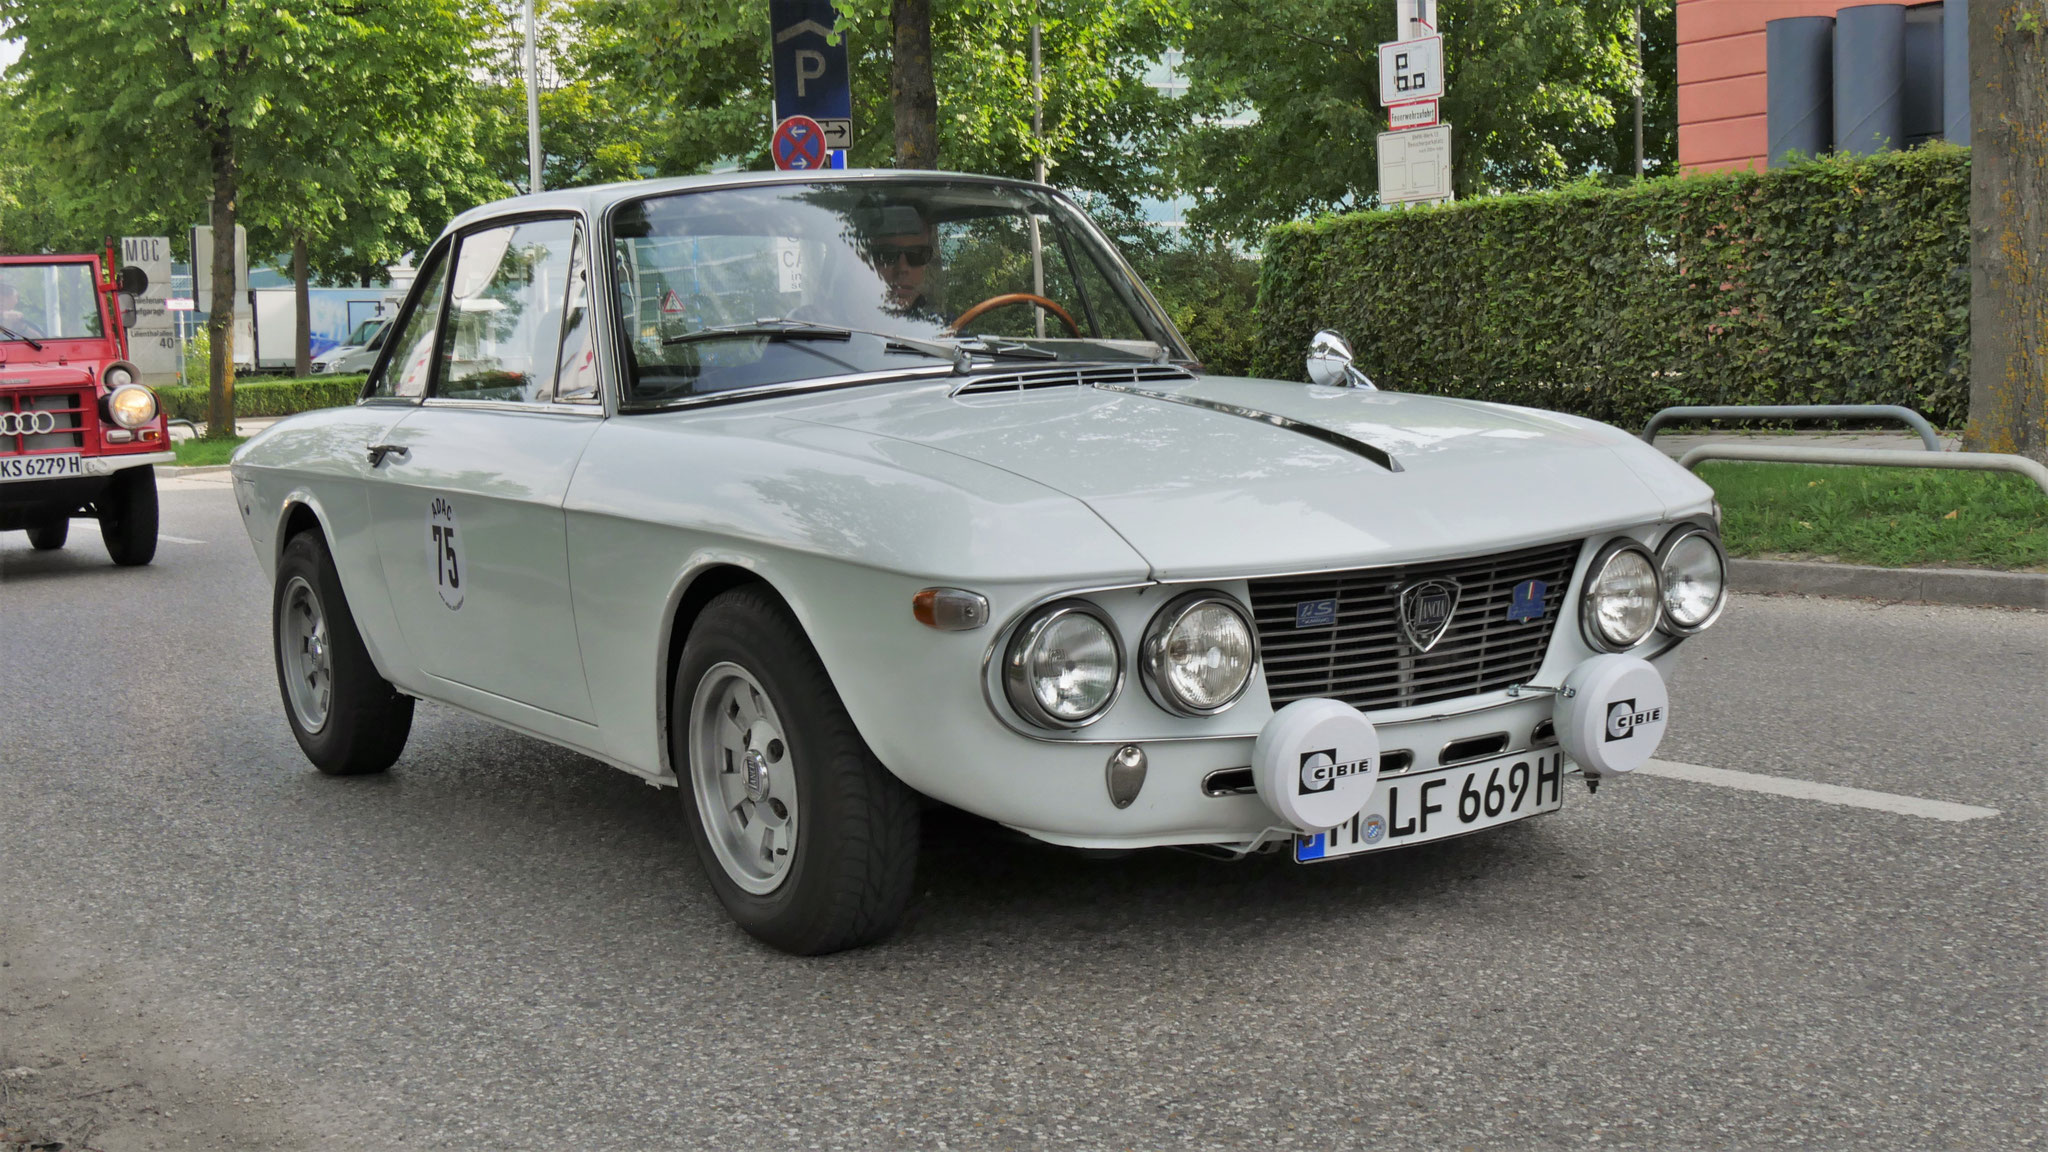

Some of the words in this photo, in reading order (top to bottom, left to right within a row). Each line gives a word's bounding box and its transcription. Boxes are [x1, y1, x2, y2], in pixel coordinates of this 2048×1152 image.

[795, 50, 826, 97] P
[1391, 107, 1434, 122] Feuerwehrzufahrt
[125, 239, 160, 261] MOC
[136, 296, 166, 306] nlieferung
[130, 330, 174, 338] Lilienthalallee
[160, 337, 174, 349] 40
[1, 460, 22, 478] KS
[26, 457, 65, 475] 6279
[431, 497, 452, 521] ADAC
[432, 525, 459, 589] 75
[1389, 778, 1446, 838] LF
